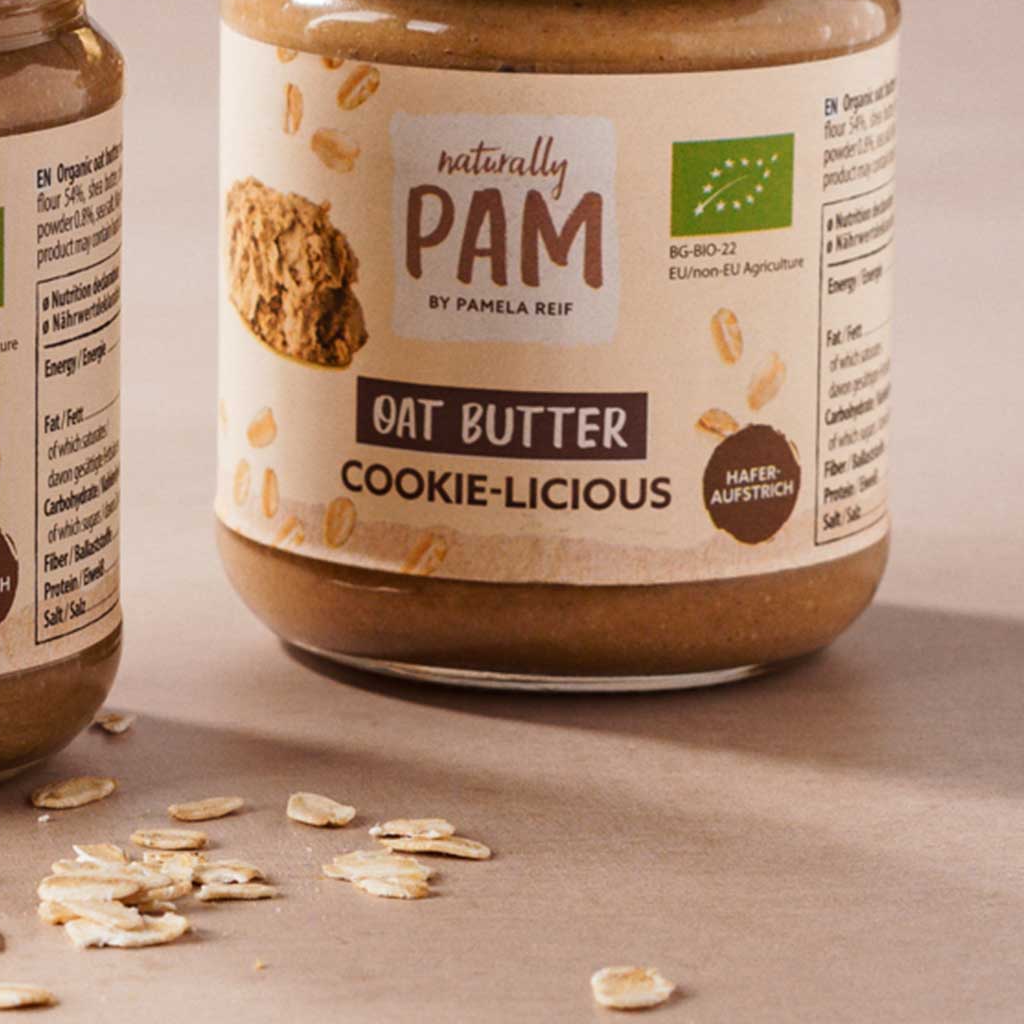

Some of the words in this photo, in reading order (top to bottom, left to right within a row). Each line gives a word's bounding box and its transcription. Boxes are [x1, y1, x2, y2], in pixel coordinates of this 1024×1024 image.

[824, 97, 838, 116] EN
[37, 168, 51, 188] EN
[57, 156, 93, 185] Organic
[437, 136, 568, 200] naturally
[37, 190, 61, 213] flour
[37, 213, 73, 244] powder
[406, 184, 603, 289] PAM
[37, 239, 74, 270] product
[669, 241, 737, 259] BG-BIO-22
[669, 263, 741, 280] EU/non-EU
[743, 257, 804, 278] Agriculture
[52, 282, 91, 309] Nutrition
[429, 295, 450, 309] BY
[456, 297, 529, 315] PAMELA
[535, 301, 574, 315] REIF
[45, 355, 77, 379] Energy
[44, 414, 60, 433] Fat
[67, 406, 84, 427] Fett
[372, 395, 444, 441] OAT
[461, 402, 628, 449] BUTTER
[48, 440, 57, 461] of
[59, 433, 80, 457] which
[48, 466, 72, 488] davon
[341, 460, 672, 510] COOKIE-LICIOUS
[726, 465, 782, 485] HAFER-
[710, 480, 794, 505] AUFSTRICH
[48, 523, 58, 543] of
[59, 515, 80, 540] which
[44, 551, 68, 573] Fiber
[44, 574, 78, 601] Protein
[44, 606, 63, 628] Salt
[70, 597, 87, 619] Salz
